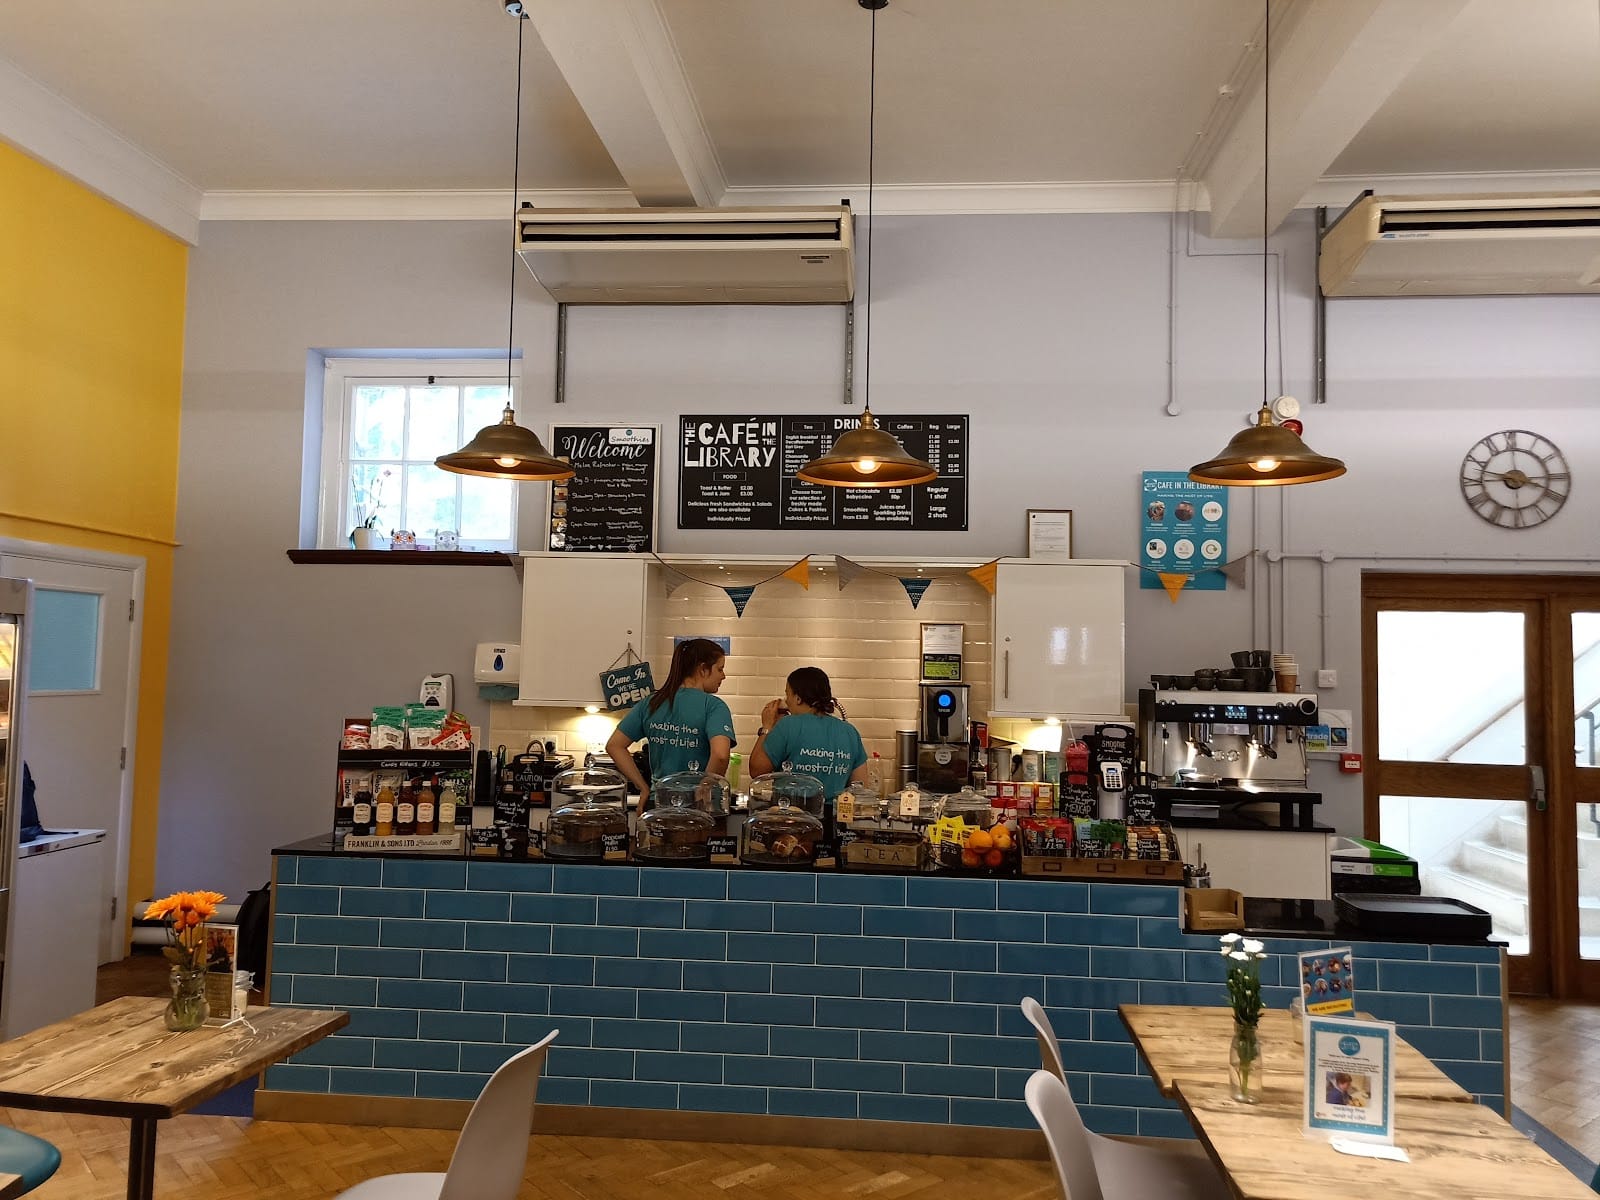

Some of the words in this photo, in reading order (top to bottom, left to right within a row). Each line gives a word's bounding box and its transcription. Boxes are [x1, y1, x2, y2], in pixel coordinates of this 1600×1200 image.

[762, 422, 776, 436] IN
[834, 418, 880, 430] DRINS
[684, 422, 696, 445] THE
[698, 417, 759, 445] CAFÉ
[562, 432, 646, 460] Welcome
[685, 447, 776, 467] LIBRARY
[607, 673, 631, 688] Come
[634, 668, 646, 680] In
[617, 682, 637, 692] WE'RE
[610, 686, 651, 707] OPEN
[681, 724, 698, 734] the
[670, 735, 678, 747] of
[800, 748, 834, 761] Making
[836, 748, 851, 760] the
[796, 763, 823, 772] most
[823, 762, 834, 773] of
[863, 848, 901, 861] TEA
